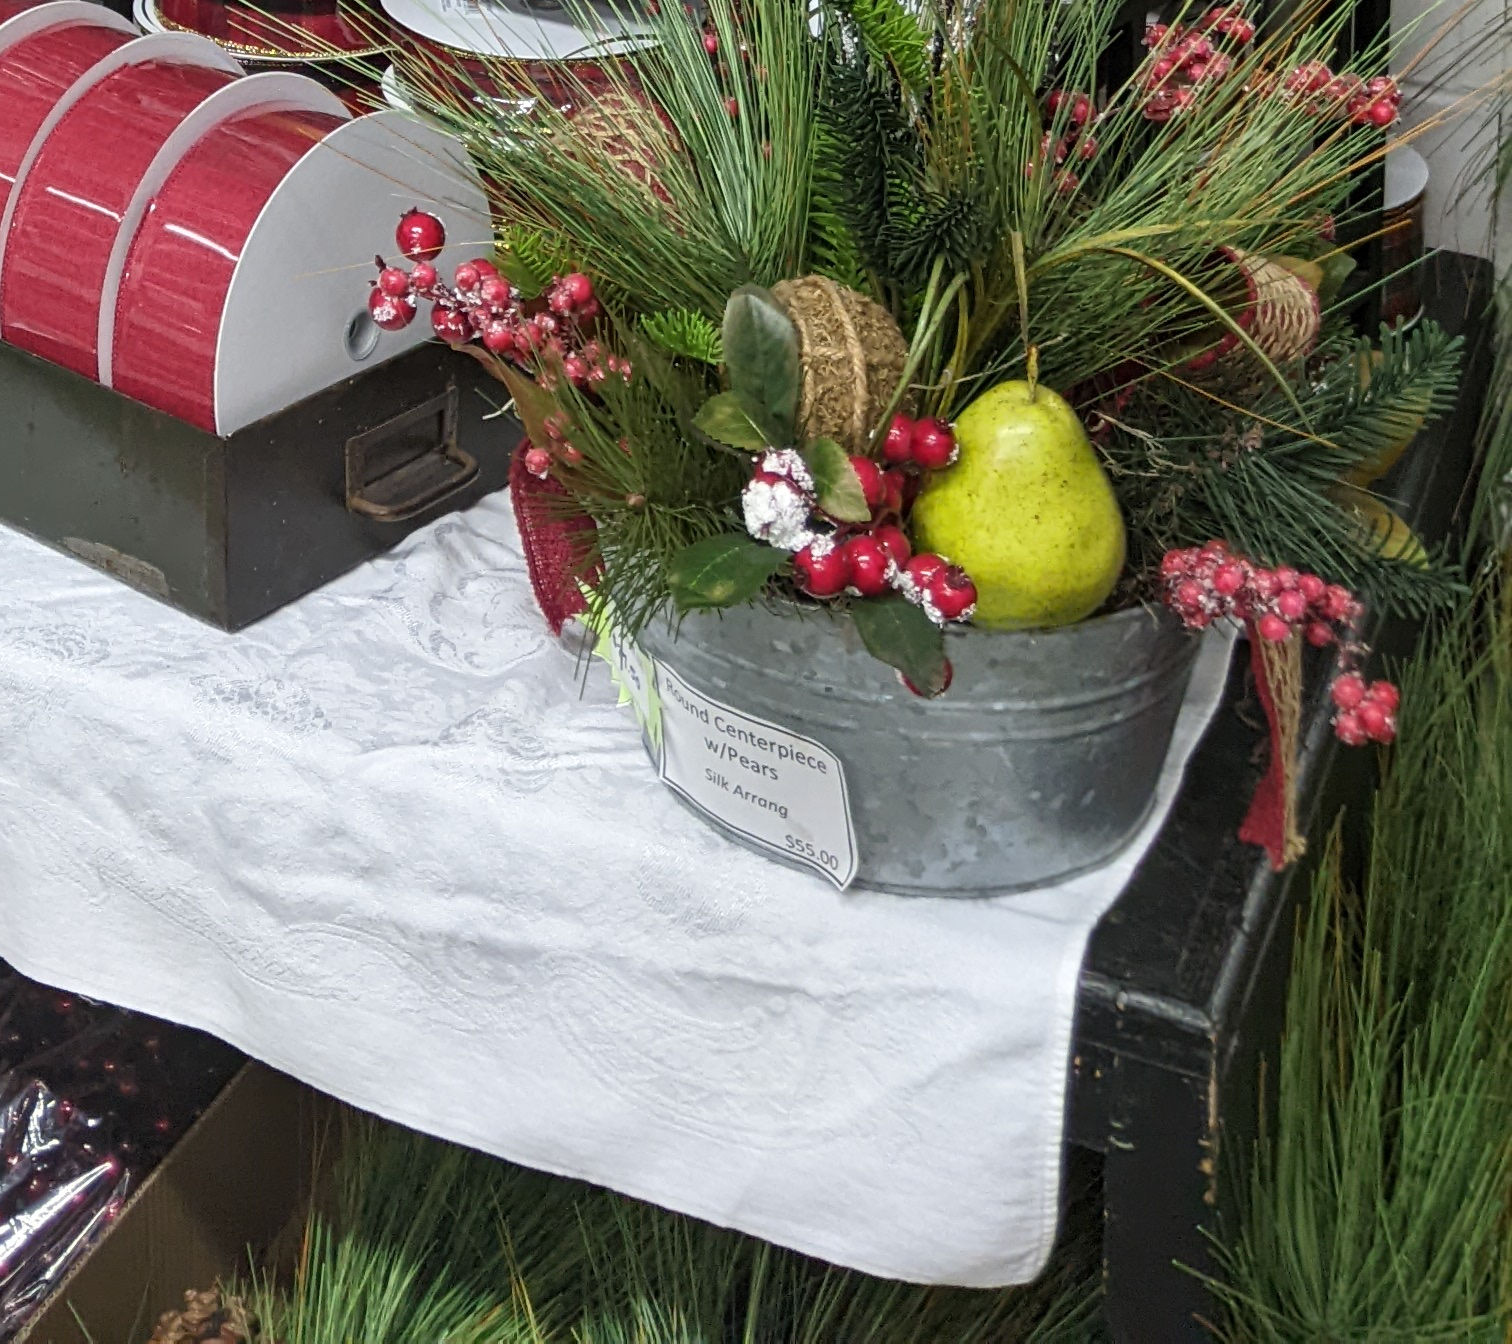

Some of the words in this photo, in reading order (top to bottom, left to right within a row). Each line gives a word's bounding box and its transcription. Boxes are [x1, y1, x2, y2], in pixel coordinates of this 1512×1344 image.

[665, 677, 710, 725] Round
[714, 715, 828, 775] Centerpiece
[704, 736, 779, 781] w/Pears
[704, 767, 729, 792] Silk
[733, 785, 789, 819] Arrang
[785, 834, 839, 871] $55.00
